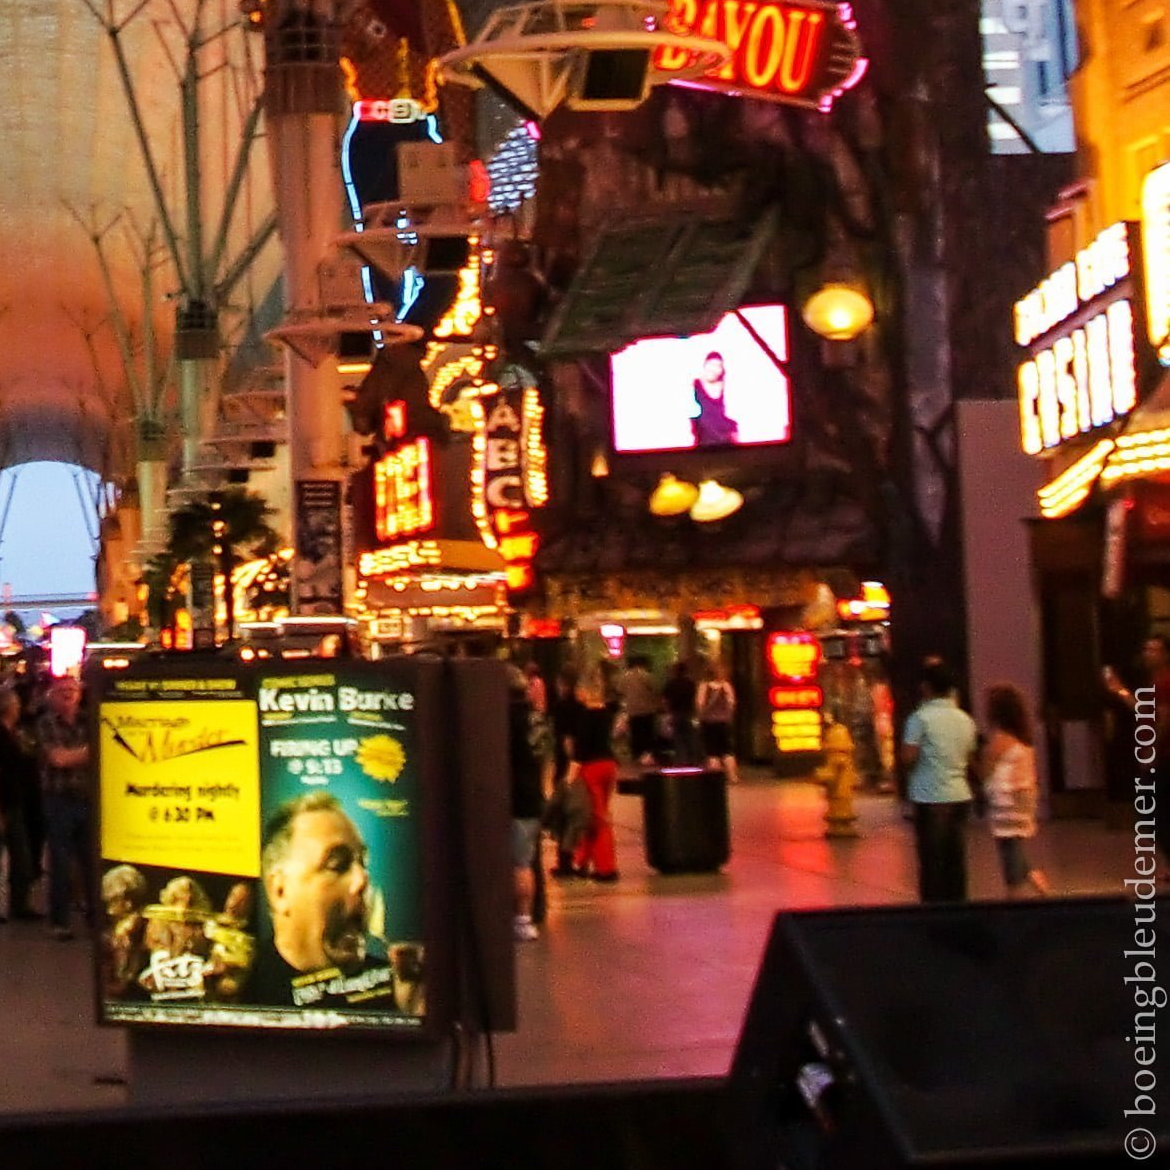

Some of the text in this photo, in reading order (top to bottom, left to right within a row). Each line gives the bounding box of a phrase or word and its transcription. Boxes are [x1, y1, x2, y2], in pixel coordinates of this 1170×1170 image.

[1016, 299, 1137, 456] CASINO
[258, 686, 415, 712] Kevin Burke
